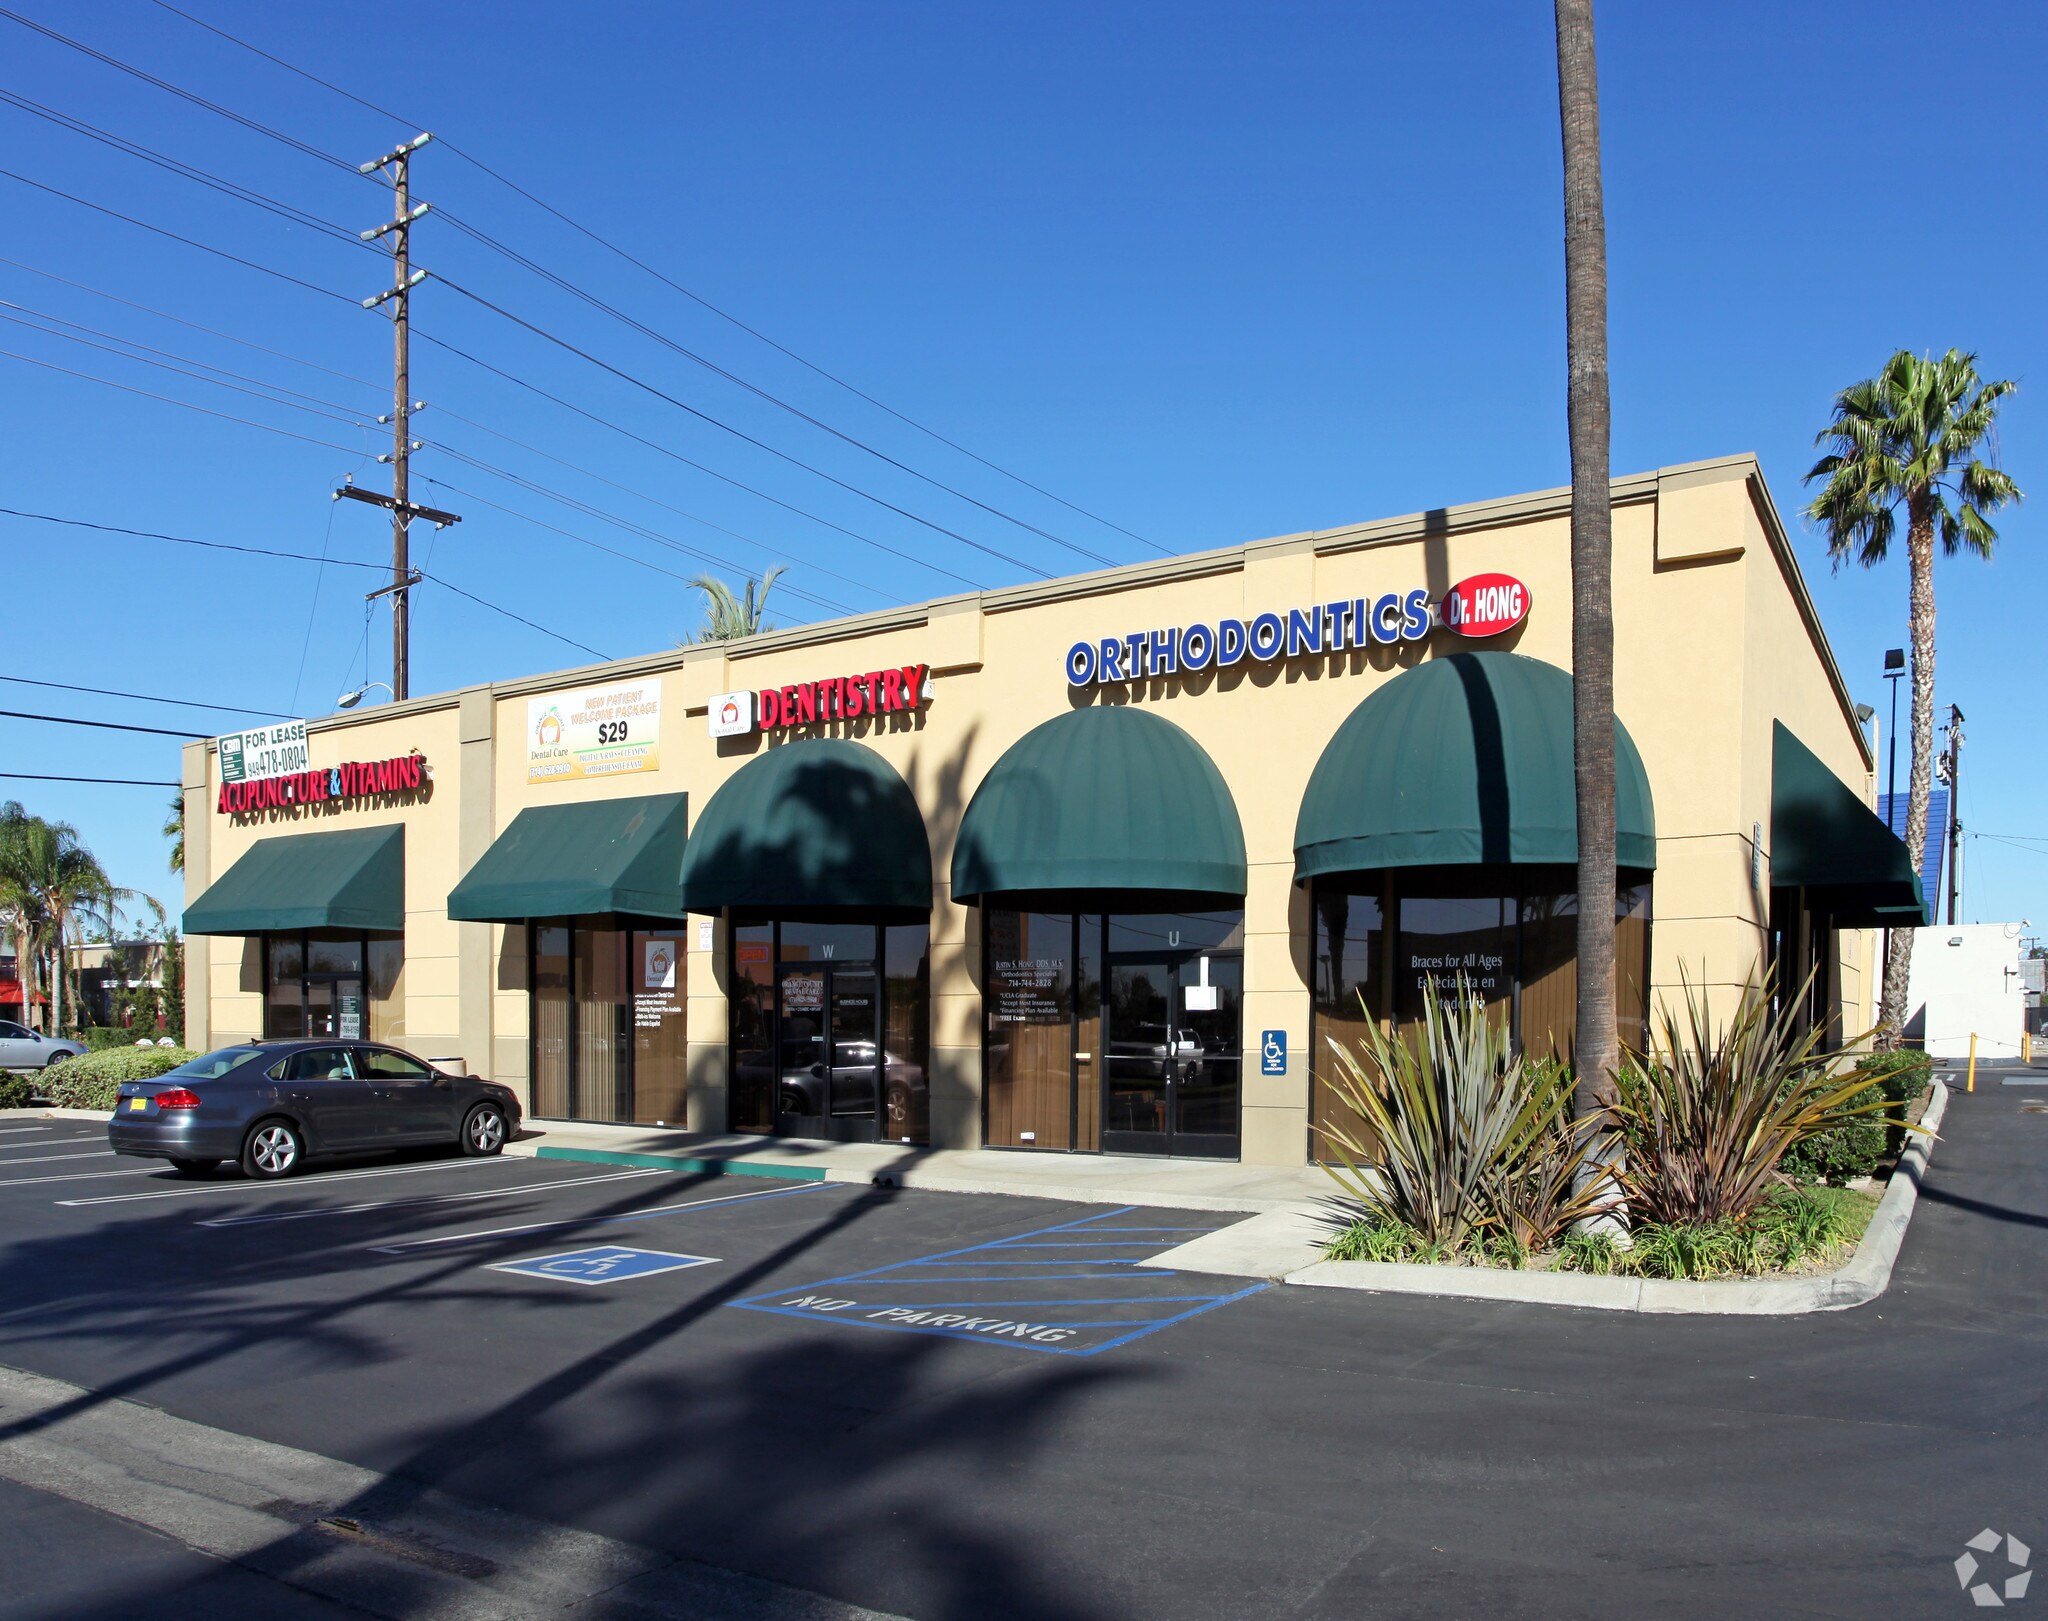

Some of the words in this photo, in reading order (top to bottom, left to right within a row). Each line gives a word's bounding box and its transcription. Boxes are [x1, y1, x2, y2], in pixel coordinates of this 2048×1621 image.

[1450, 591, 1471, 626] Dr.
[1474, 583, 1522, 623] HONG
[1064, 587, 1432, 688] ORTHODONTICS
[585, 696, 605, 710] NEW
[606, 690, 643, 706] PATIENT
[758, 664, 929, 729] DENTISTRY
[571, 709, 614, 725] WELCOME
[615, 701, 658, 718] PACKAGE
[245, 731, 267, 749] FOR
[270, 724, 306, 745] LEASE
[598, 720, 628, 746] $29
[531, 748, 552, 760] Dental
[553, 747, 569, 758] Care
[217, 768, 328, 814] ACUPUNCTURE
[329, 768, 341, 795] &
[340, 755, 423, 796] VITAMINS
[1168, 931, 1179, 947] U
[822, 945, 834, 959] W
[1411, 955, 1442, 968] Braces
[1445, 954, 1460, 968] for
[1462, 953, 1476, 967] All
[1477, 954, 1503, 971] Ages
[352, 960, 358, 971] Y
[1481, 977, 1495, 988] en
[780, 1295, 857, 1311] NO
[865, 1307, 1077, 1342] PARKING
